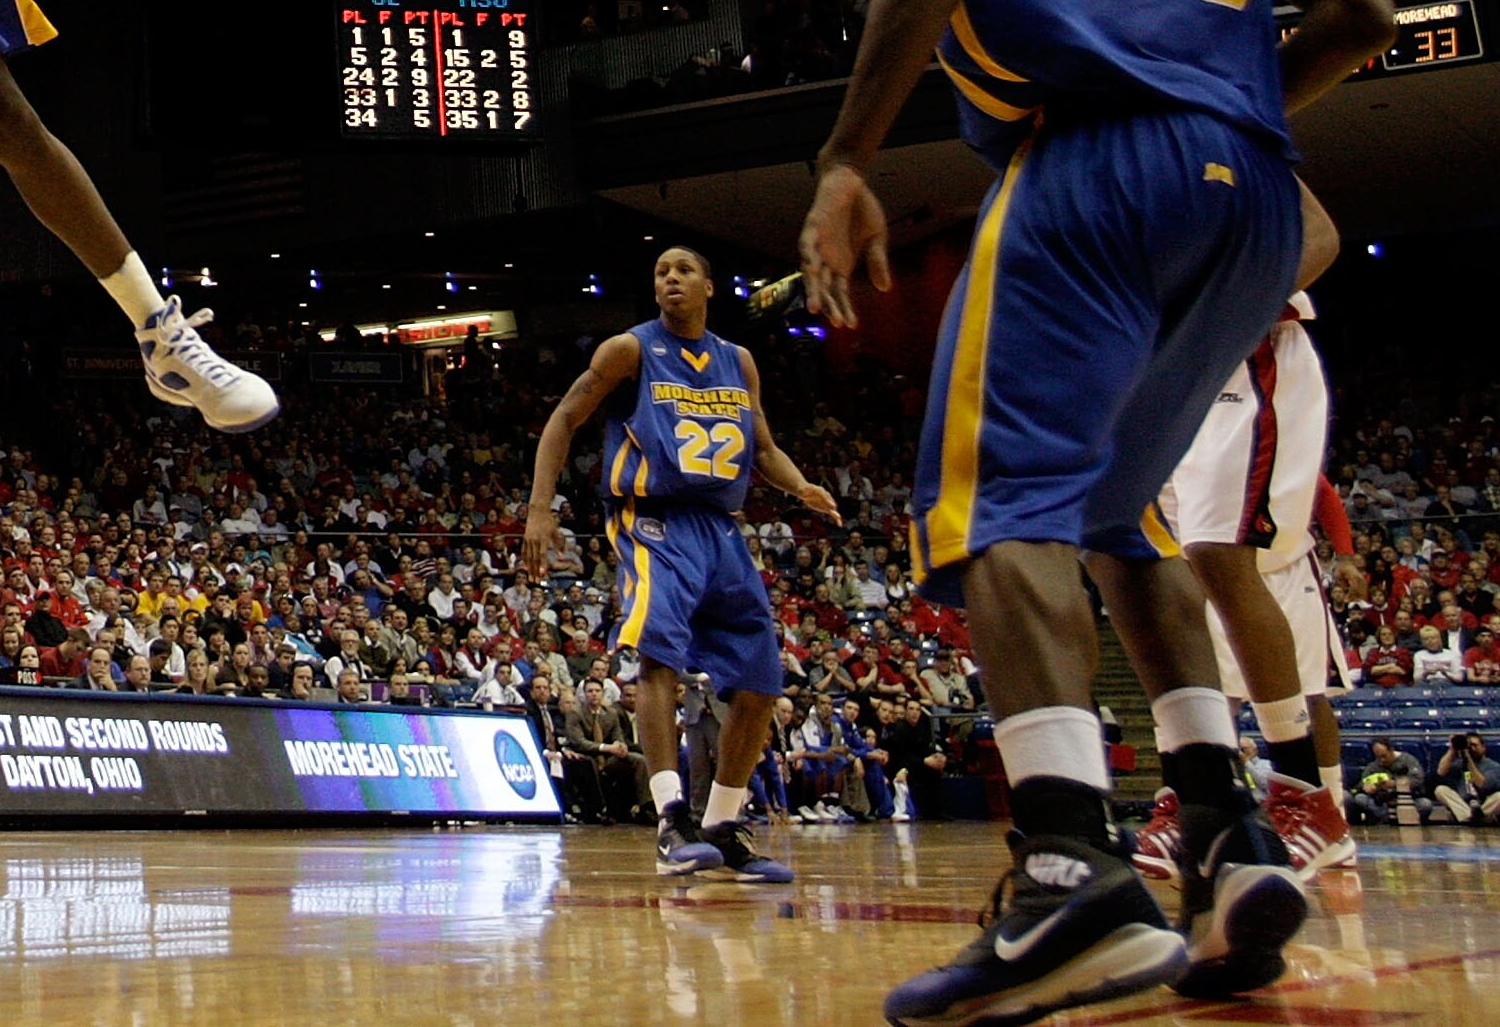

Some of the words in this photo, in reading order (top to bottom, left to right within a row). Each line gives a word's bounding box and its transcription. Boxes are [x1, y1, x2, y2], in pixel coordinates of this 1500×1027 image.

[343, 10, 367, 24] PL
[379, 11, 392, 24] F
[404, 11, 429, 25] PT
[441, 12, 465, 26] PL
[476, 13, 489, 26] F
[501, 13, 526, 27] PT
[1393, 4, 1459, 25] MOREHEAD
[352, 27, 363, 45] 1
[381, 27, 393, 46] 1
[408, 28, 426, 46] 5
[451, 29, 463, 47] 1
[508, 30, 526, 49] 9
[1414, 27, 1458, 63] 33
[351, 47, 368, 66] 5
[380, 47, 398, 66] 2
[410, 48, 427, 66] 4
[444, 49, 470, 68] 15
[480, 49, 498, 68] 2
[509, 50, 527, 69] 5
[342, 67, 375, 86] 24
[381, 68, 399, 86] 2
[411, 68, 428, 87] 9
[443, 69, 476, 88] 22
[511, 70, 529, 89] 2
[344, 88, 377, 107] 33
[385, 88, 396, 107] 1
[412, 89, 430, 108] 3
[444, 89, 477, 108] 33
[483, 90, 500, 109] 2
[512, 91, 529, 110] 8
[344, 108, 378, 127] 34
[413, 109, 431, 128] 5
[446, 110, 479, 129] 35
[486, 110, 498, 129] 1
[513, 111, 531, 130] 7
[652, 384, 750, 409] MOREHEAD
[676, 401, 740, 420] STATE
[674, 419, 745, 480] 22
[18, 715, 66, 749] AND
[65, 717, 149, 752] SECOND
[148, 720, 229, 754] ROUNDS
[283, 740, 400, 777] MOREHEAD
[398, 744, 459, 779] STATE
[0, 754, 95, 795] DAYTON,
[90, 756, 143, 790] OHIO
[502, 763, 536, 784] NCAA
